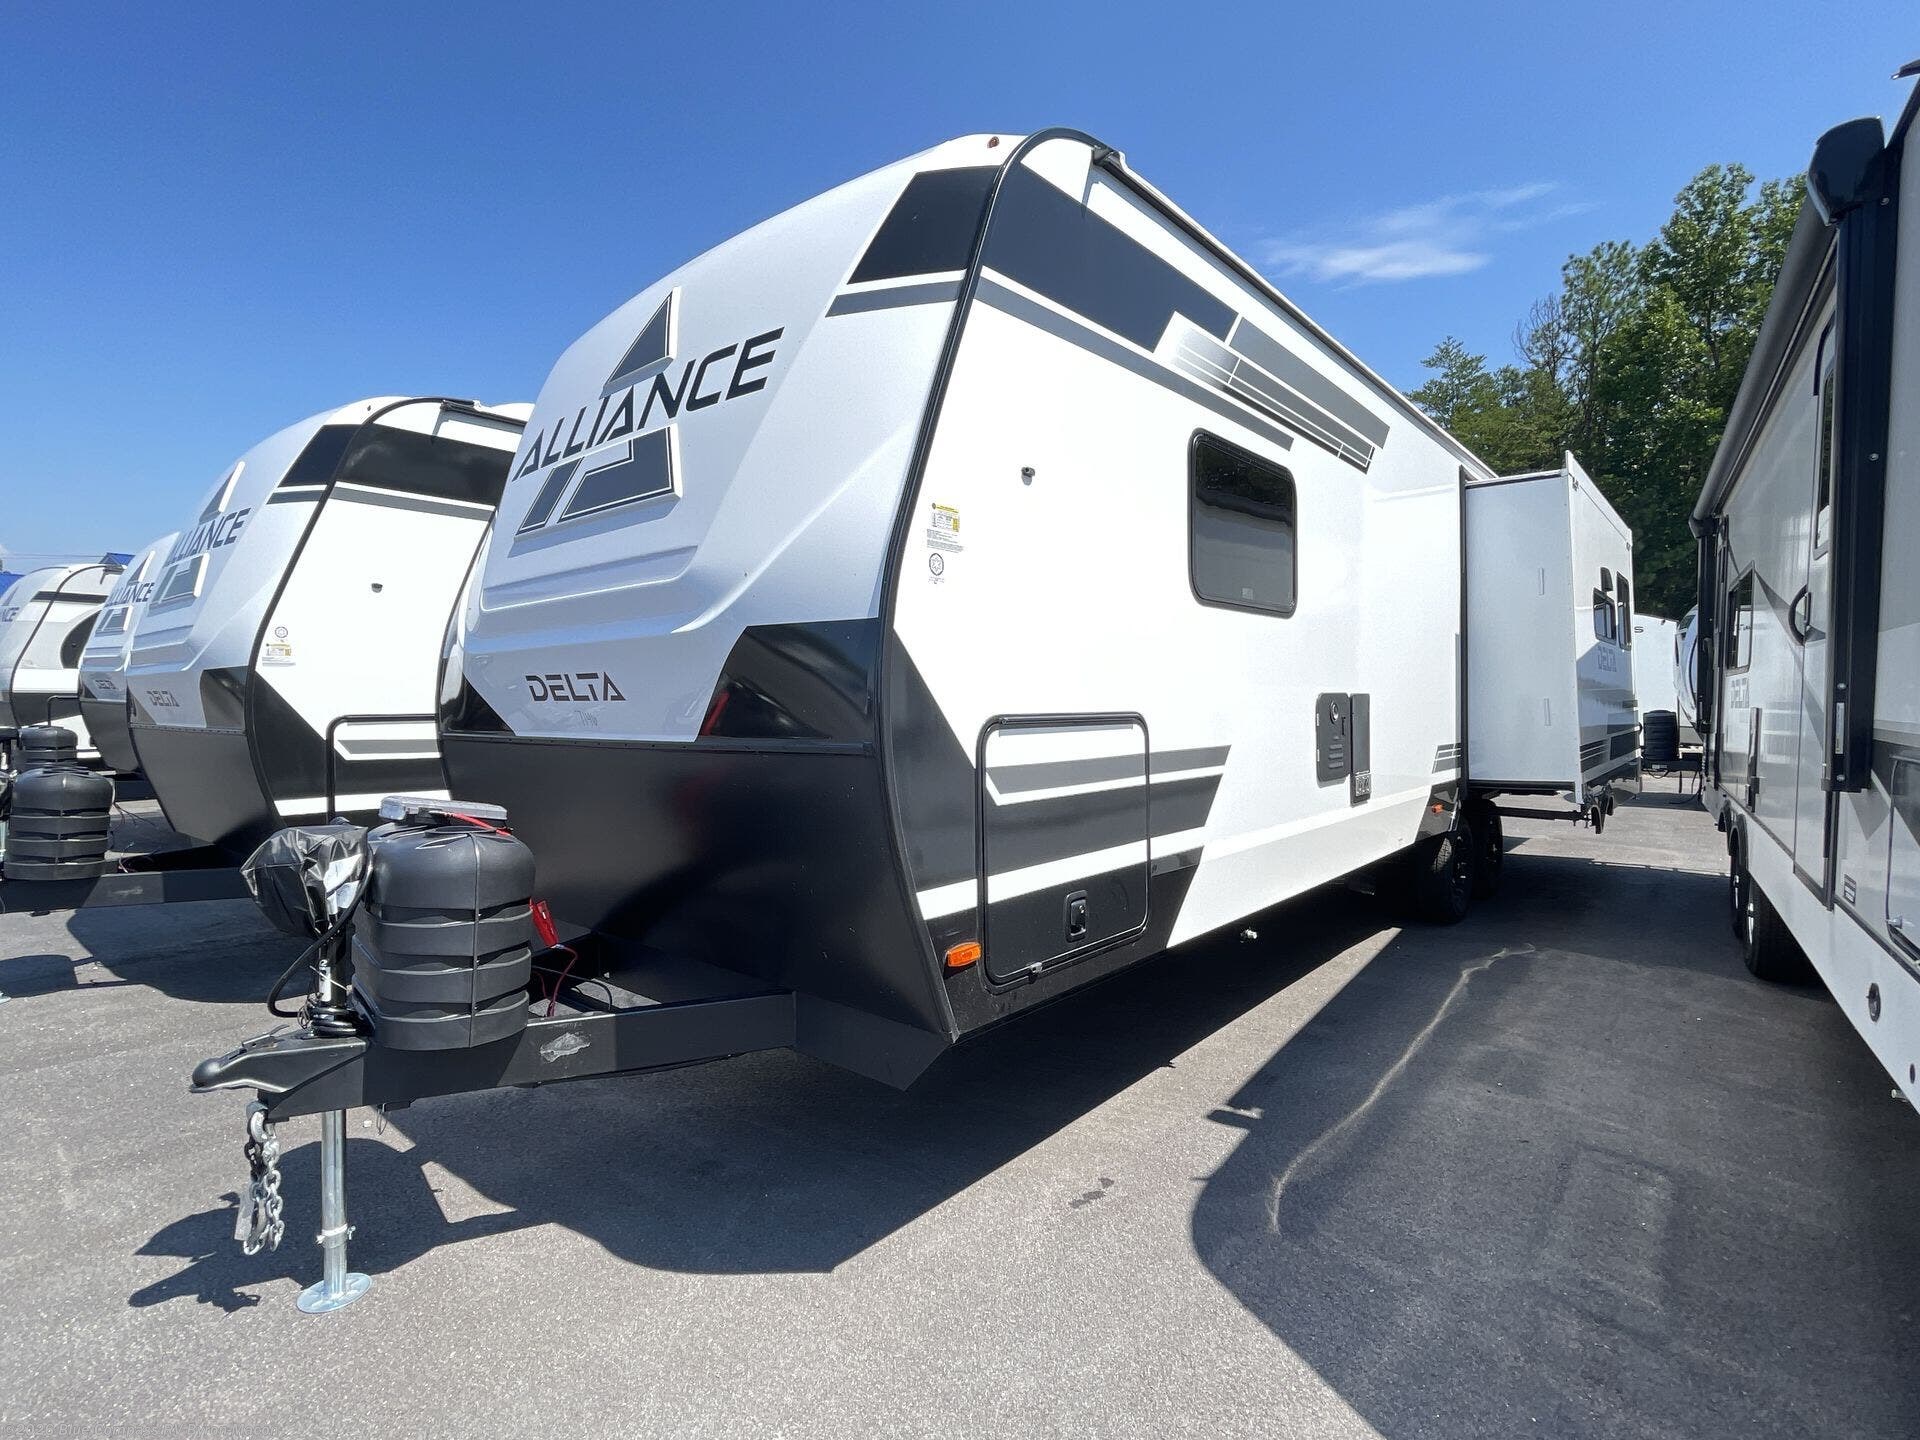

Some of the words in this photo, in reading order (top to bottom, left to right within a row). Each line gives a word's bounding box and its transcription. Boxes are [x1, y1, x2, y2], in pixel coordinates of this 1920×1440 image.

[512, 326, 786, 482] ALLIANCE
[163, 507, 252, 567] ALLIANCE
[146, 690, 180, 707] DELTA
[525, 671, 626, 702] DELTA
